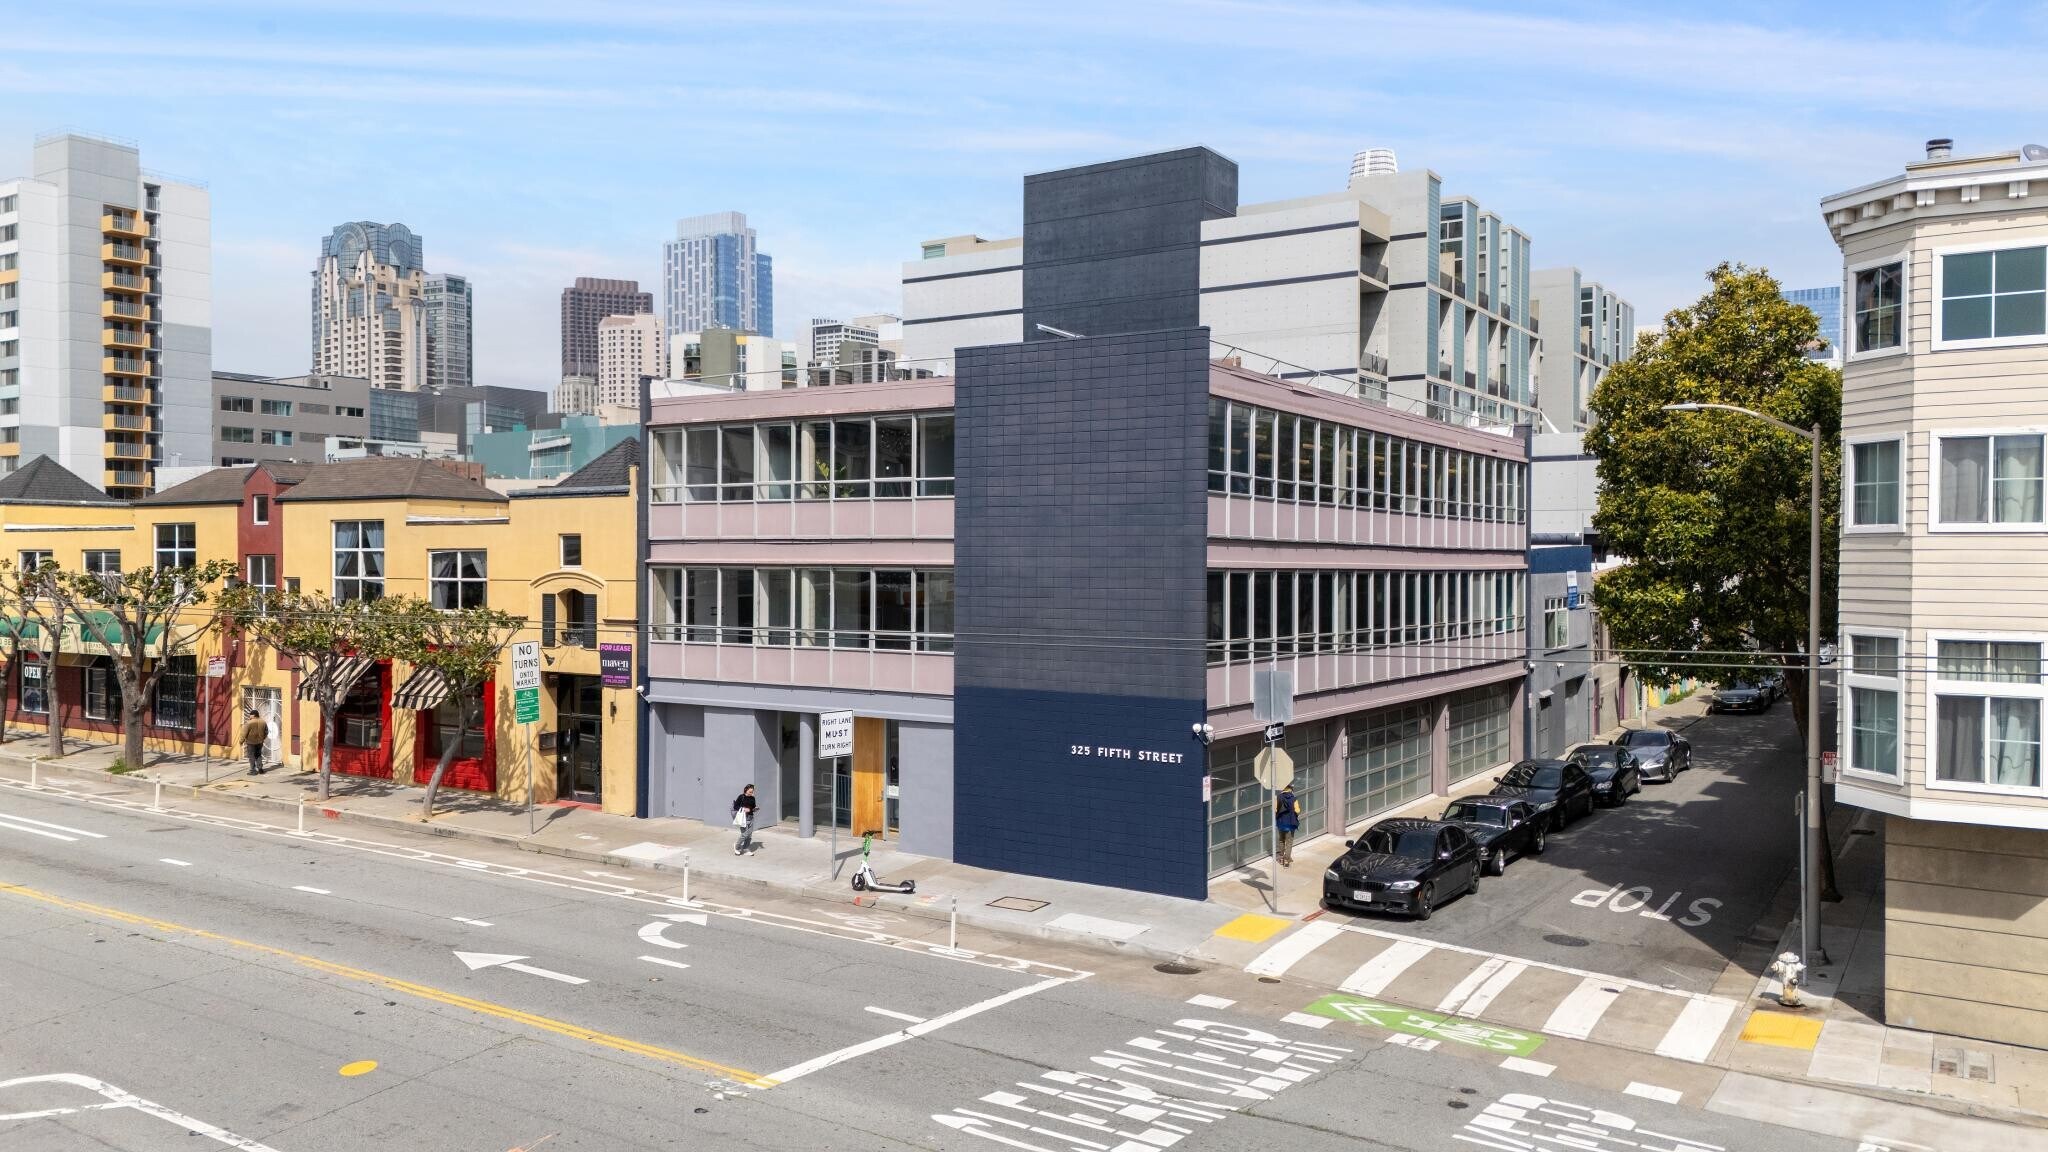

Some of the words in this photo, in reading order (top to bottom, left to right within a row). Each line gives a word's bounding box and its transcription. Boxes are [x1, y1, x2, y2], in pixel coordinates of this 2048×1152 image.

[518, 645, 532, 655] NO
[514, 659, 538, 669] TURNS
[602, 660, 628, 668] maven
[24, 666, 41, 679] OPEN
[520, 671, 534, 679] ONTO
[516, 678, 538, 686] MARKET
[826, 729, 848, 738] MUST
[1071, 745, 1090, 756] 325
[1098, 747, 1130, 759] FIFTH
[1138, 750, 1183, 764] STREET
[1569, 882, 1724, 927] STOP
